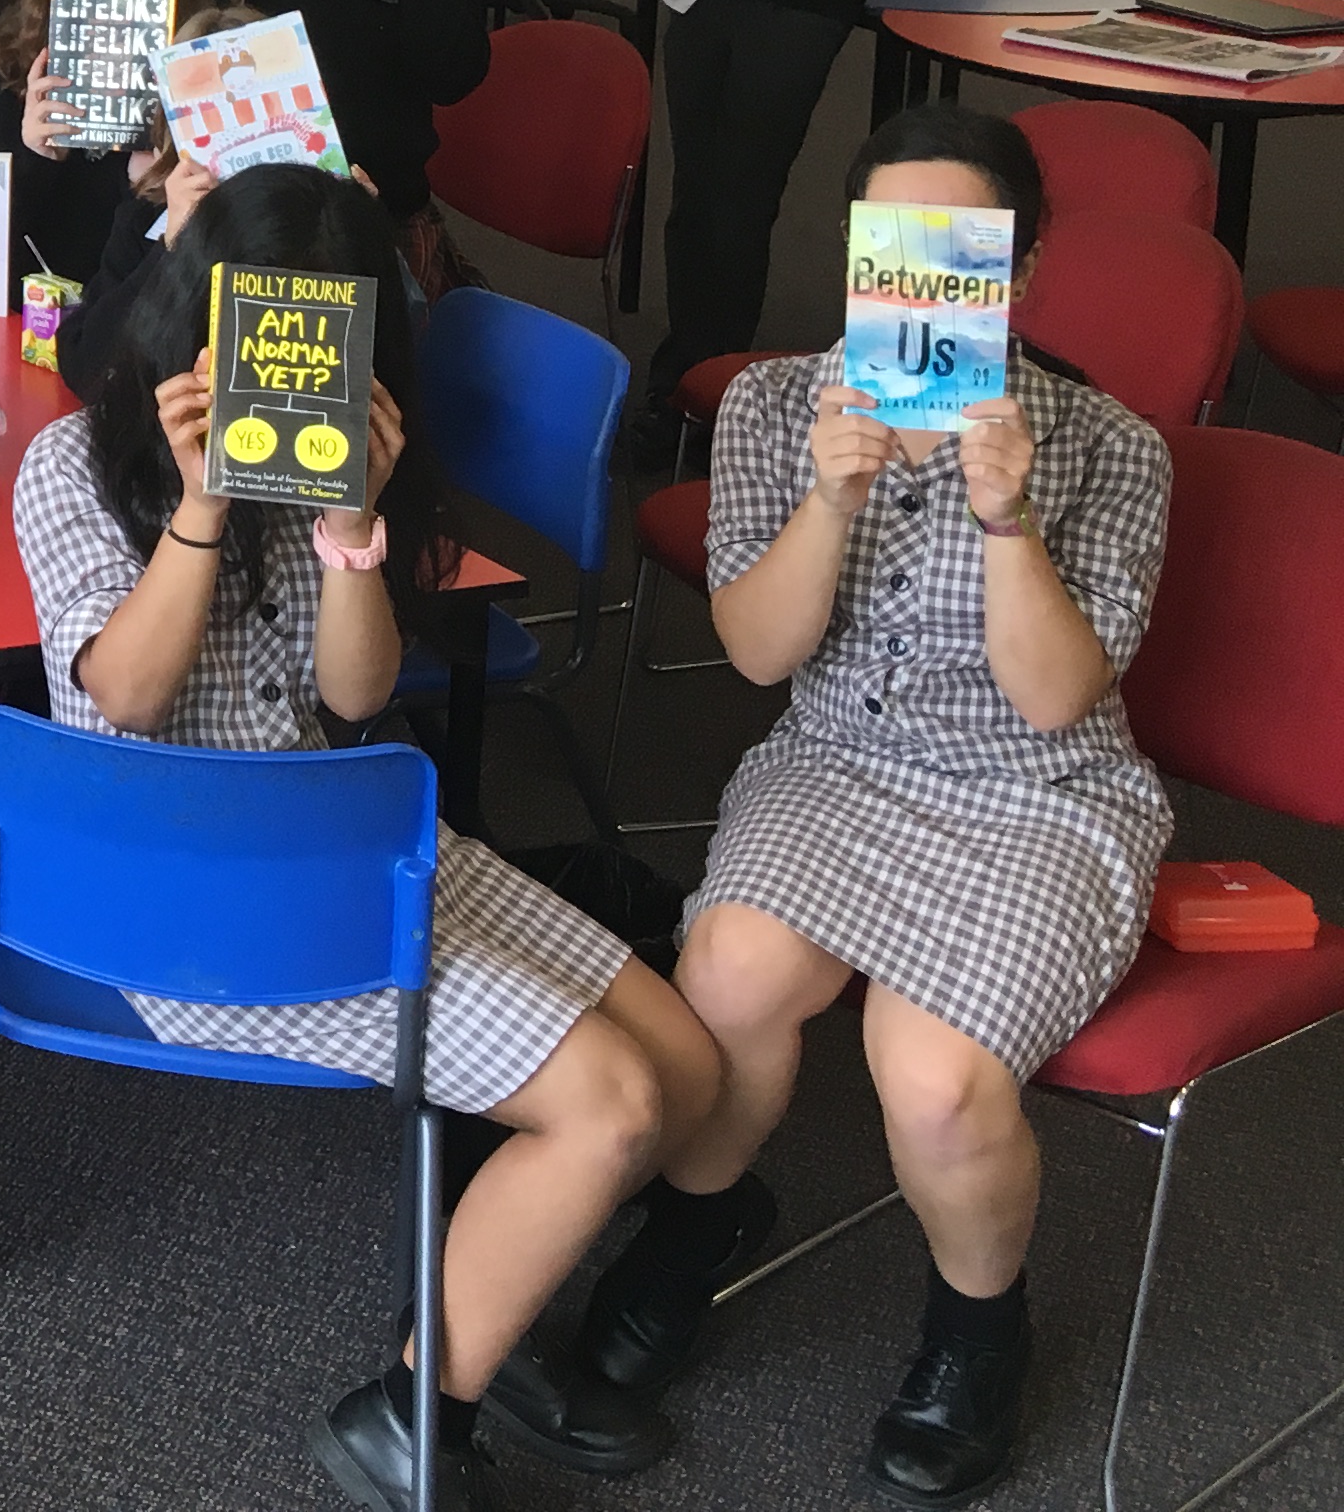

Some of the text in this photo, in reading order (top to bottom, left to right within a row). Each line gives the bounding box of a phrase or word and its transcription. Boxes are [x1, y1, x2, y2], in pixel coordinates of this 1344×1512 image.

[54, 23, 166, 56] LIFEL1K3
[89, 130, 139, 144] KRISTOFF
[225, 143, 293, 172] YOUR BED
[233, 271, 358, 305] HOLLY BOURNE
[852, 256, 1005, 306] Between
[257, 308, 327, 341] AM I
[240, 336, 341, 366] NORMAL
[897, 320, 957, 377] Us
[252, 362, 331, 392] YET?
[235, 429, 265, 451] YES
[309, 438, 337, 458] NO
[298, 486, 310, 496] The
[312, 488, 344, 499] Observer
